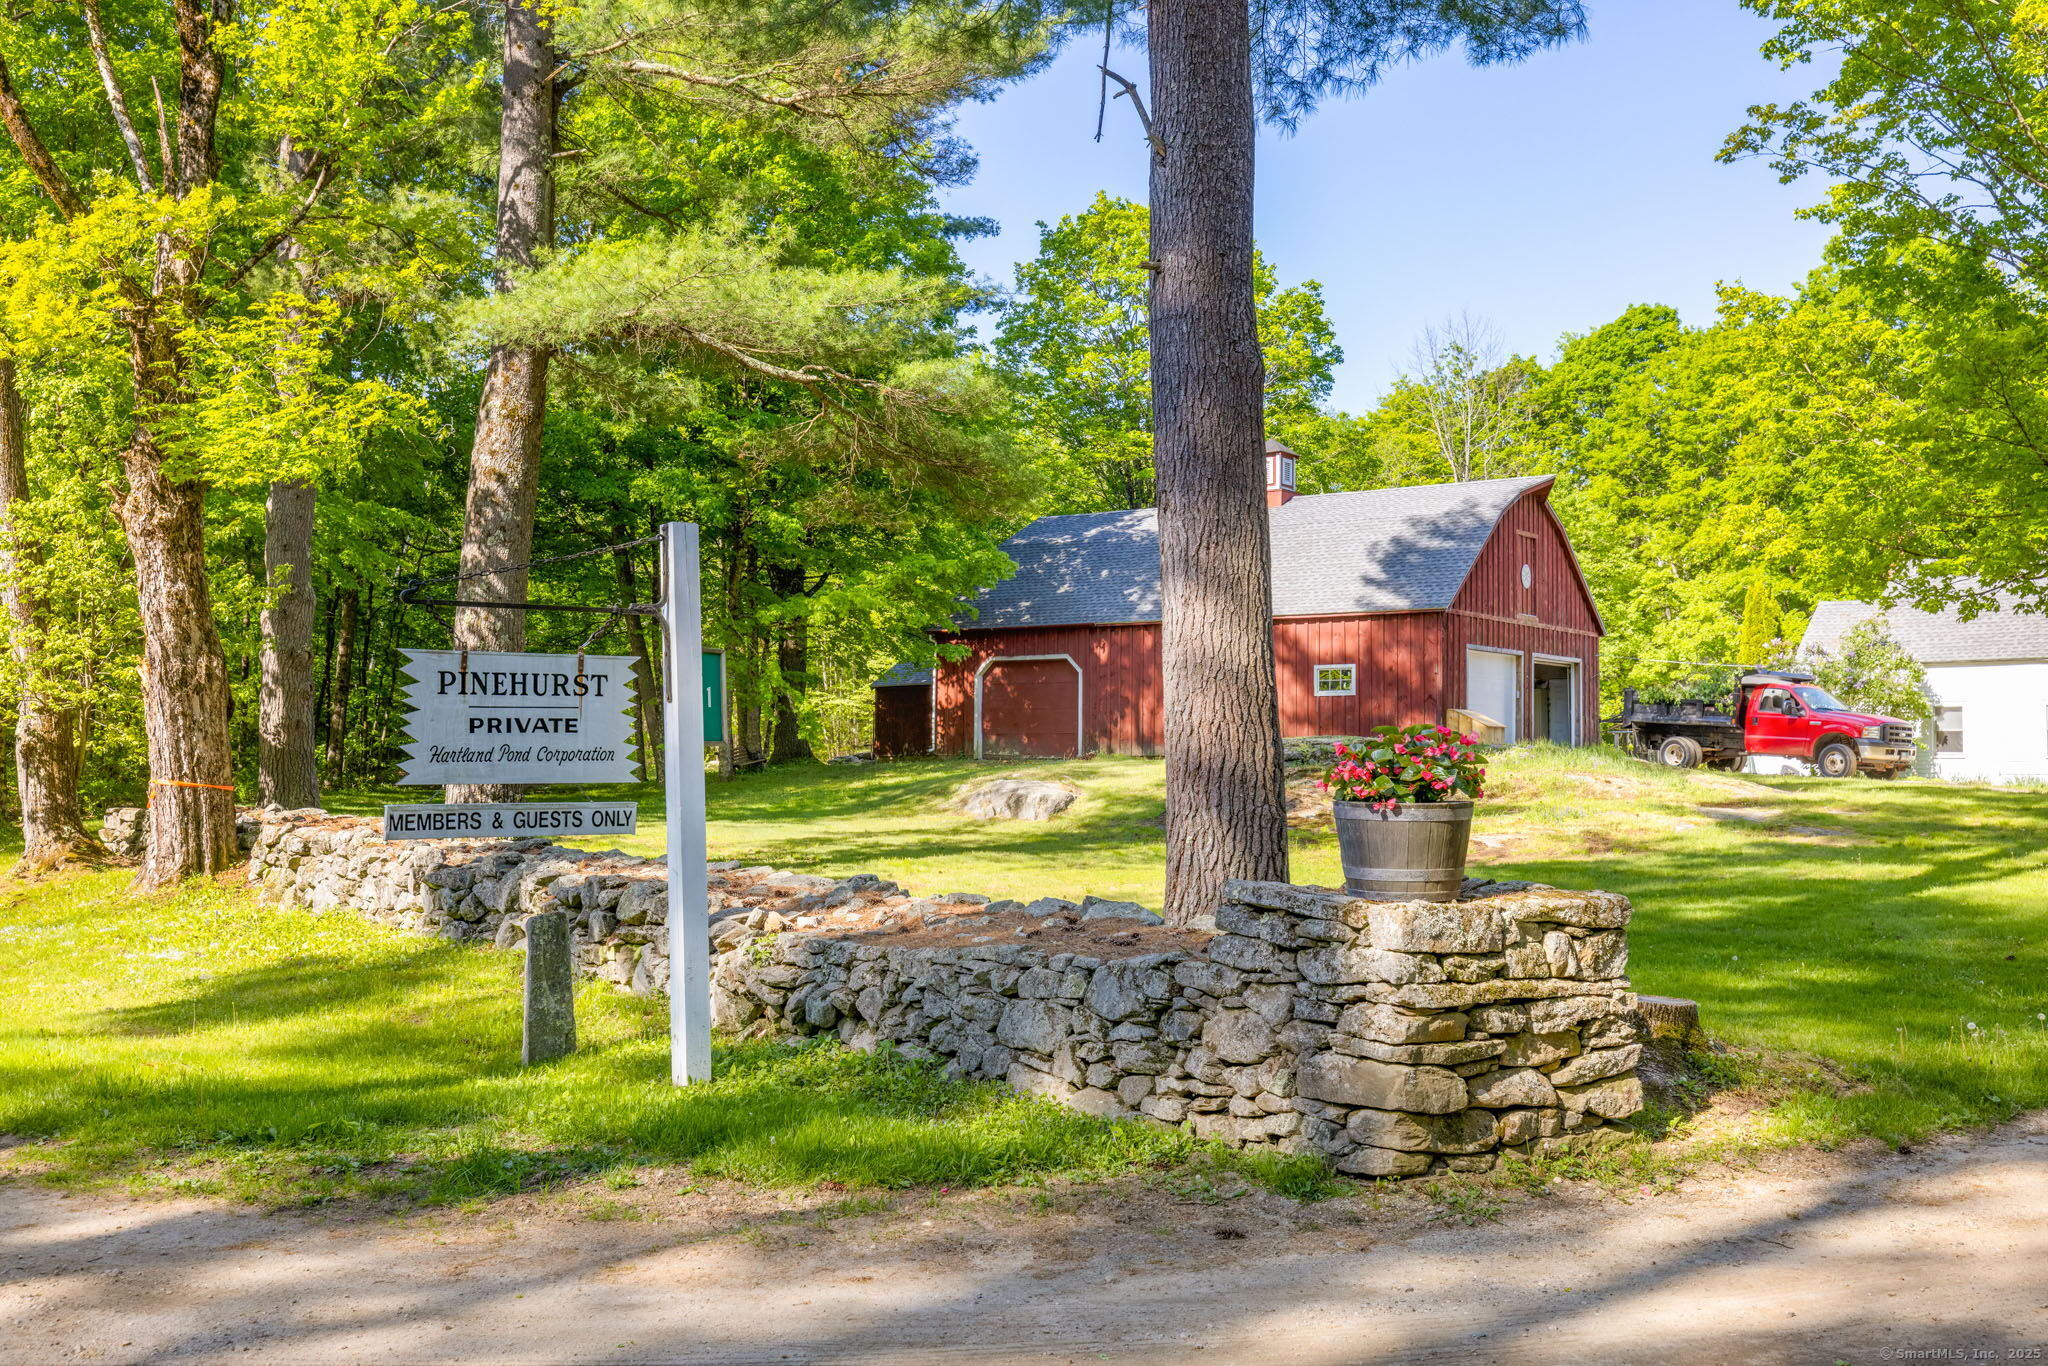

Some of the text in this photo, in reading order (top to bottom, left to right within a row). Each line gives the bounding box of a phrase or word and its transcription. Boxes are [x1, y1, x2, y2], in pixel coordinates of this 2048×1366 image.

[437, 670, 609, 697] PINEHURST
[468, 717, 579, 734] PRIVATE
[429, 744, 615, 766] Hartland Pond Corporation
[388, 810, 633, 832] MEMBERS & GUESTS ONLY
